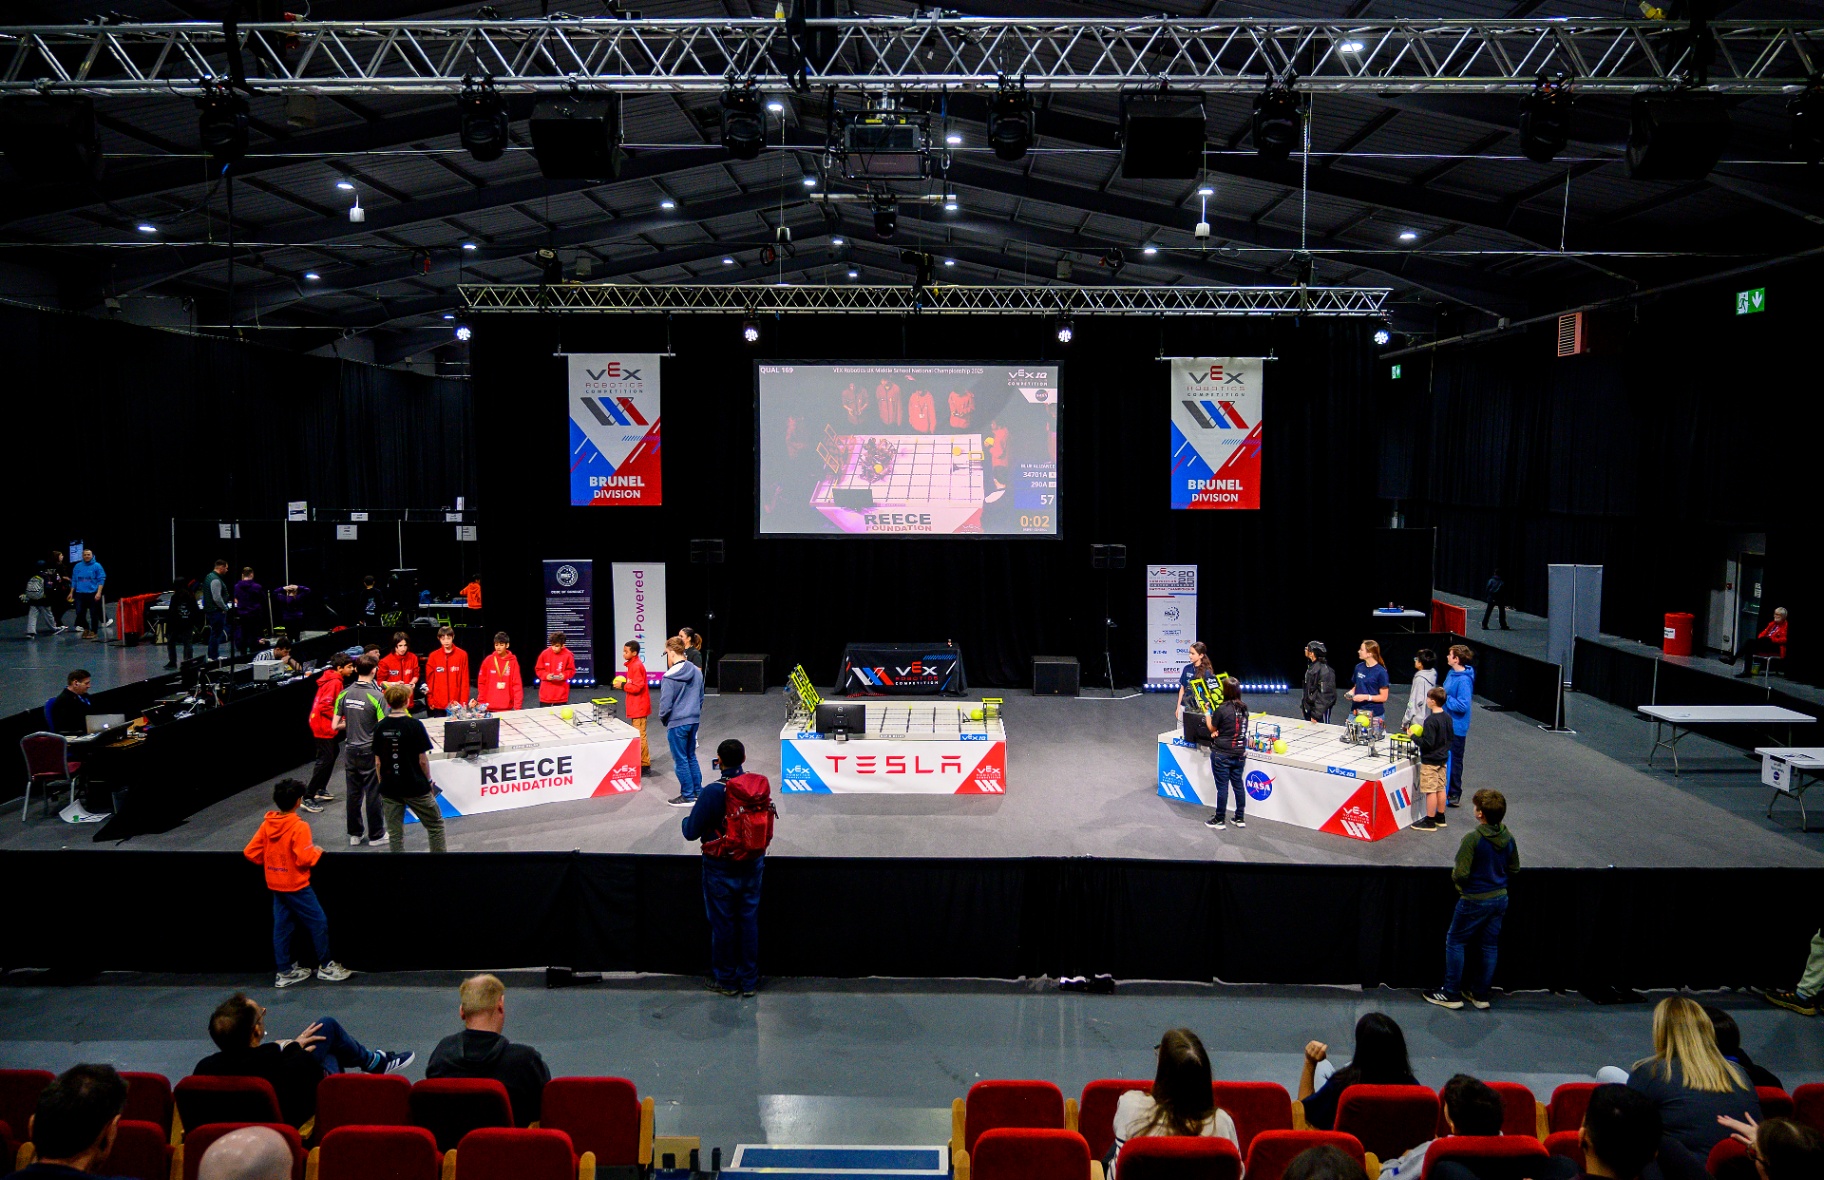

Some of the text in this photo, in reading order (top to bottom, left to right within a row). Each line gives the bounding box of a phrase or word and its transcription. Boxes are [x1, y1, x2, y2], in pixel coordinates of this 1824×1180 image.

[586, 362, 642, 380] VEX
[1009, 369, 1034, 378] VEX
[1188, 366, 1244, 384] VEX
[590, 476, 645, 486] BRUNEL
[1188, 480, 1243, 490] BRUNEL
[594, 490, 641, 498] DIVISION
[1192, 493, 1238, 502] DIVISION
[1040, 495, 1055, 505] 57
[864, 514, 931, 524] REECE
[1020, 516, 1050, 528] 0:02
[1150, 568, 1176, 576] VEX
[633, 570, 645, 632] Powered
[896, 662, 937, 676] VEX
[613, 765, 636, 774] VEX
[786, 765, 810, 774] VEX
[825, 756, 961, 774] TESLA
[481, 756, 572, 785] REECE
[1163, 770, 1183, 780] VEX
[481, 776, 573, 796] FOUNDATION
[1247, 781, 1270, 790] NASA
[1343, 806, 1369, 818] VEX
